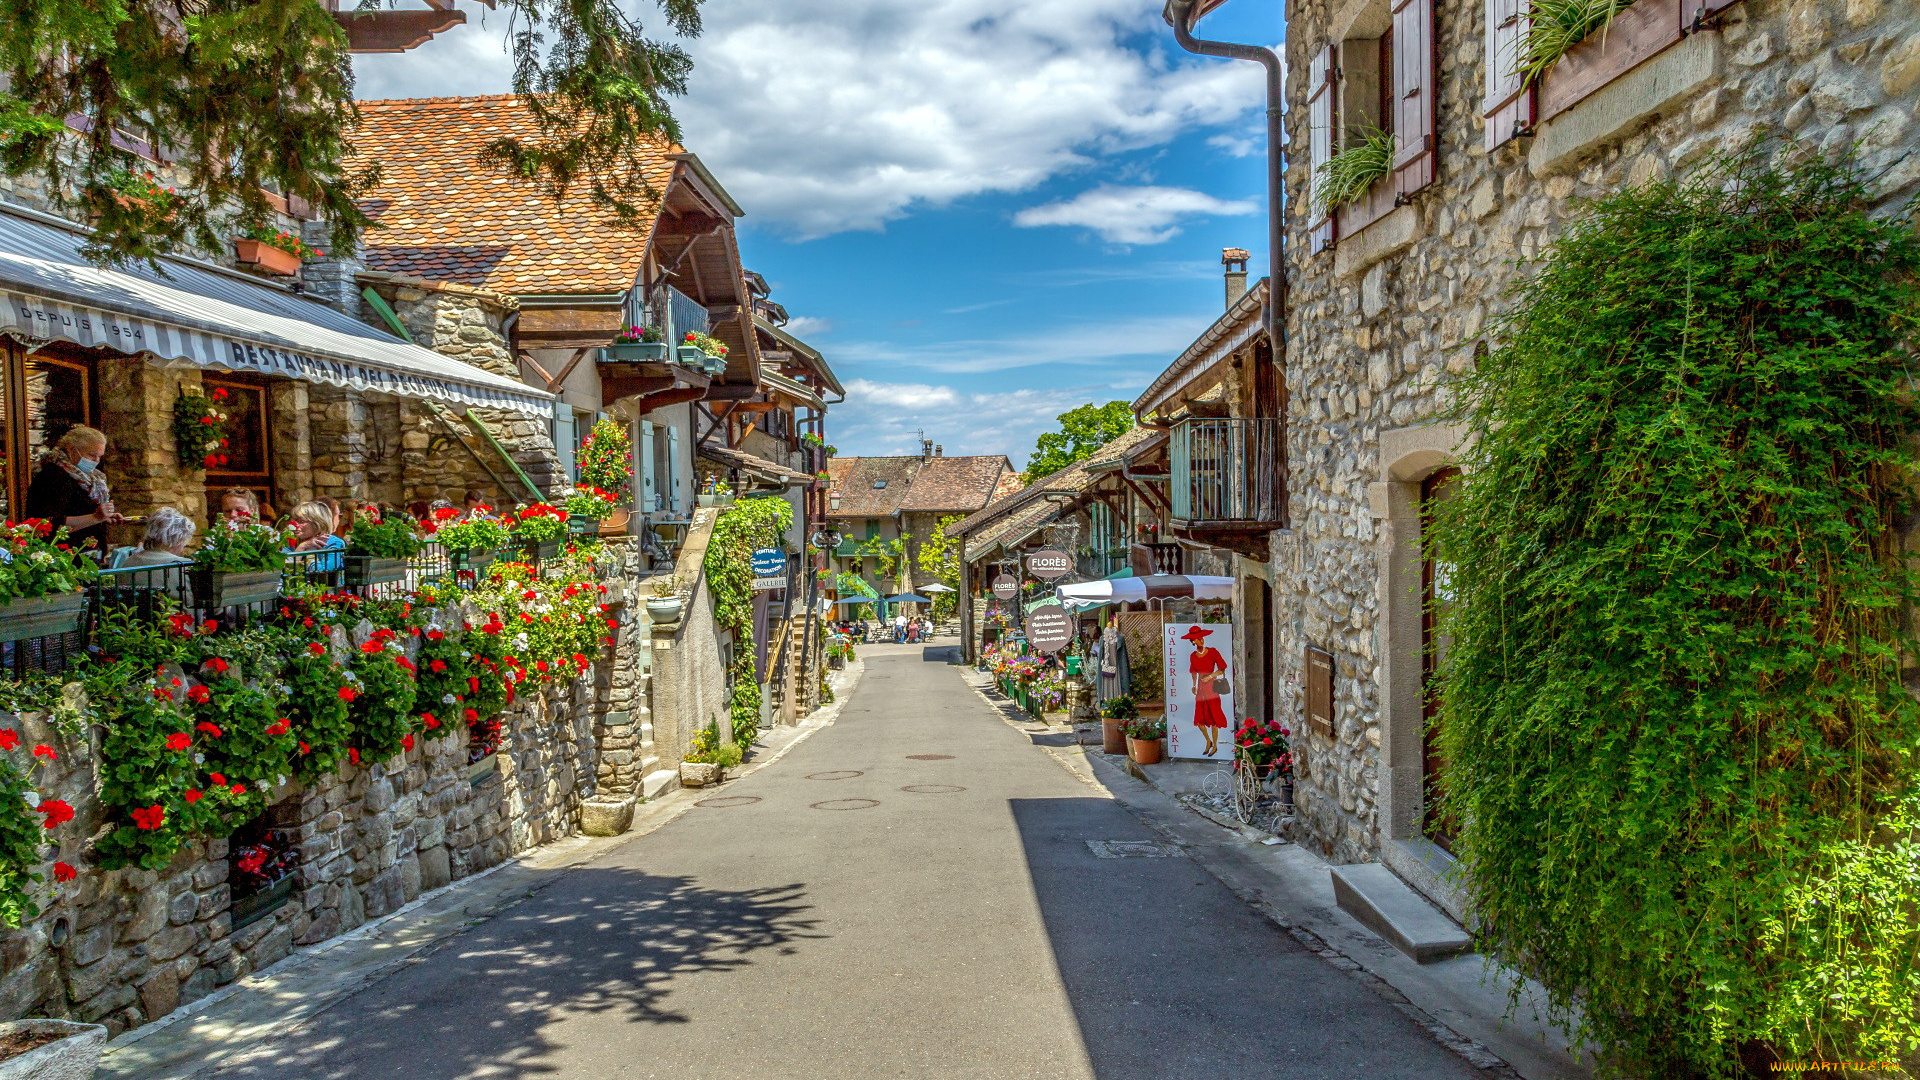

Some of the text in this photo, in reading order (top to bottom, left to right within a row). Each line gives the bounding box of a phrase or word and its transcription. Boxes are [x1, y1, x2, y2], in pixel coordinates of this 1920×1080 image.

[20, 307, 142, 341] DEPUIS 1954
[231, 342, 351, 381] RESTAURANT
[358, 366, 384, 388] DES
[1032, 557, 1067, 567] FLORÈS
[1168, 626, 1178, 697] GALERIE
